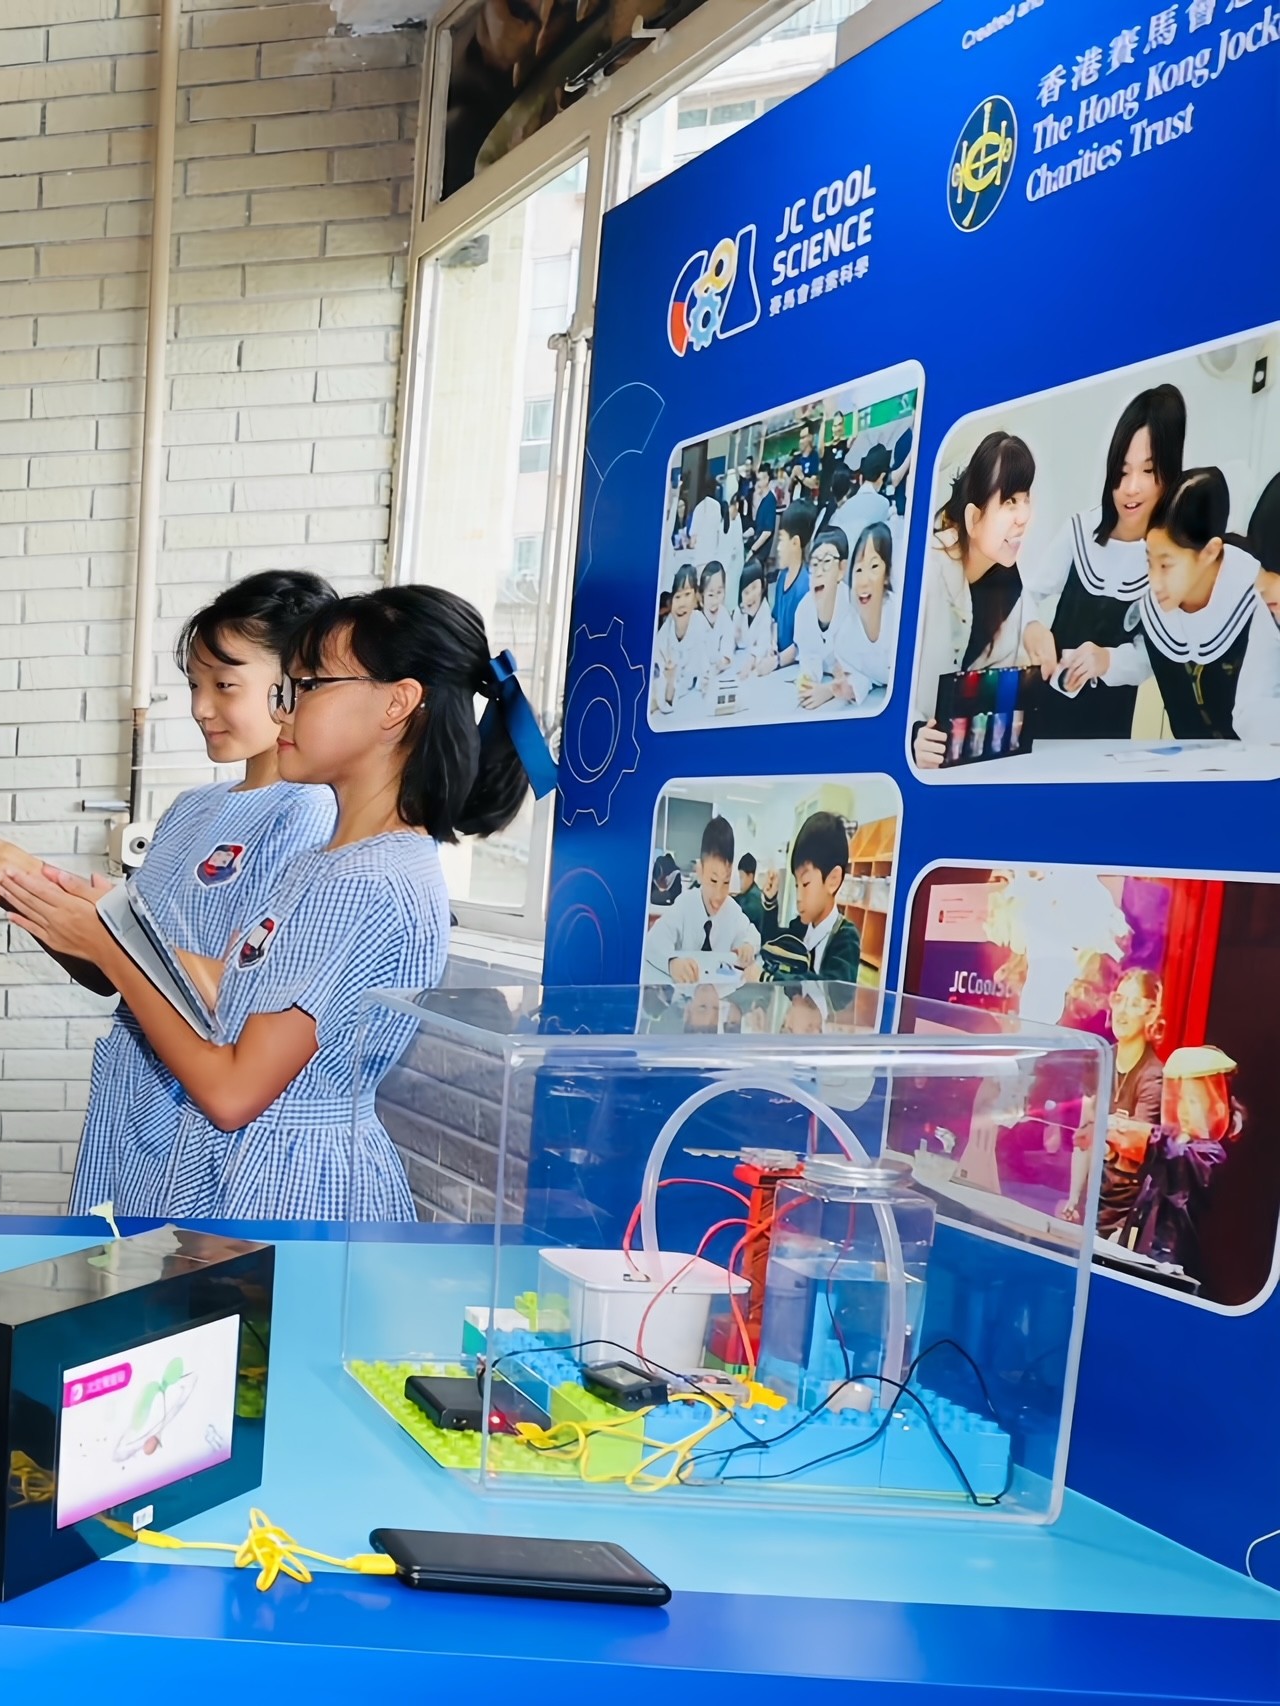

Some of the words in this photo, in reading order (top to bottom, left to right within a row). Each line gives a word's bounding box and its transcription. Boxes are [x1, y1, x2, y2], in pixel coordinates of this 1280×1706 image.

[1033, 113, 1073, 155] The
[1077, 82, 1141, 134] Hong
[1145, 48, 1212, 101] Kong
[1025, 142, 1123, 202] Charities
[1130, 102, 1195, 158] Trust
[771, 207, 874, 286] SCIENCE
[775, 198, 806, 243] JC
[812, 164, 877, 223] COOL
